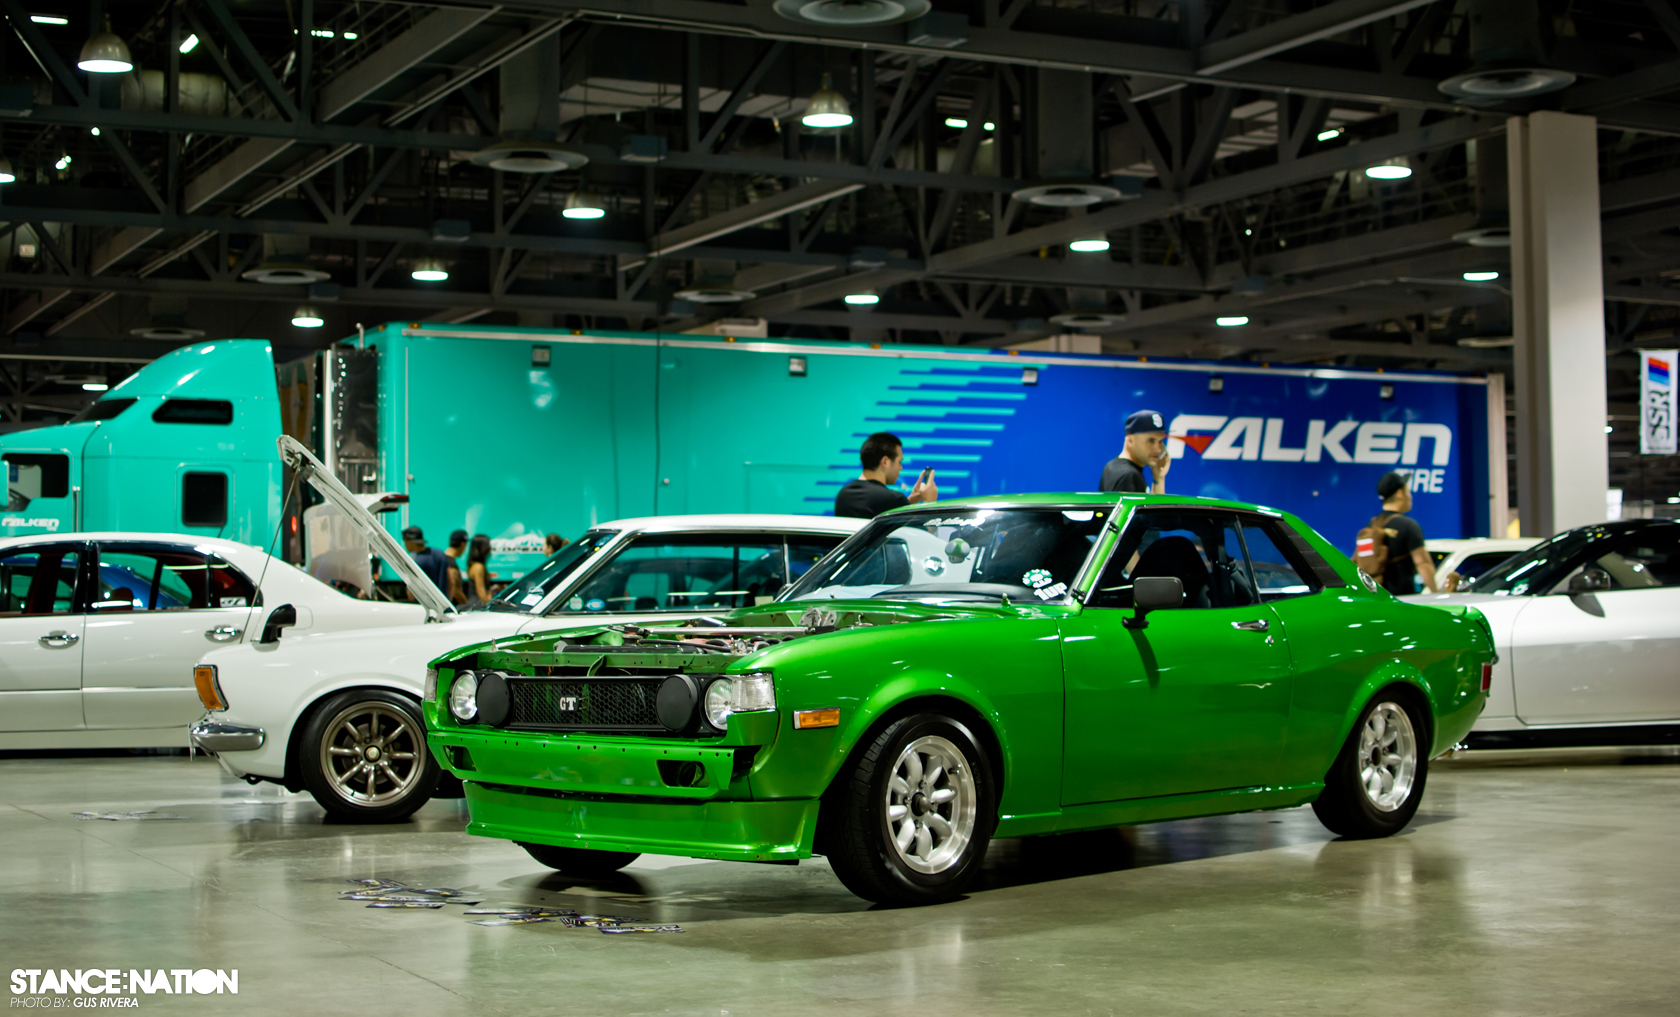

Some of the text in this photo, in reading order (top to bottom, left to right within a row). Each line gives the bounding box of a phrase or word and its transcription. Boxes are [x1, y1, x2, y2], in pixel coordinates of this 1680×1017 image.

[1648, 390, 1670, 440] SSR
[1167, 414, 1453, 466] FALKEN
[1, 517, 60, 528] FALKEN
[559, 696, 577, 711] GT
